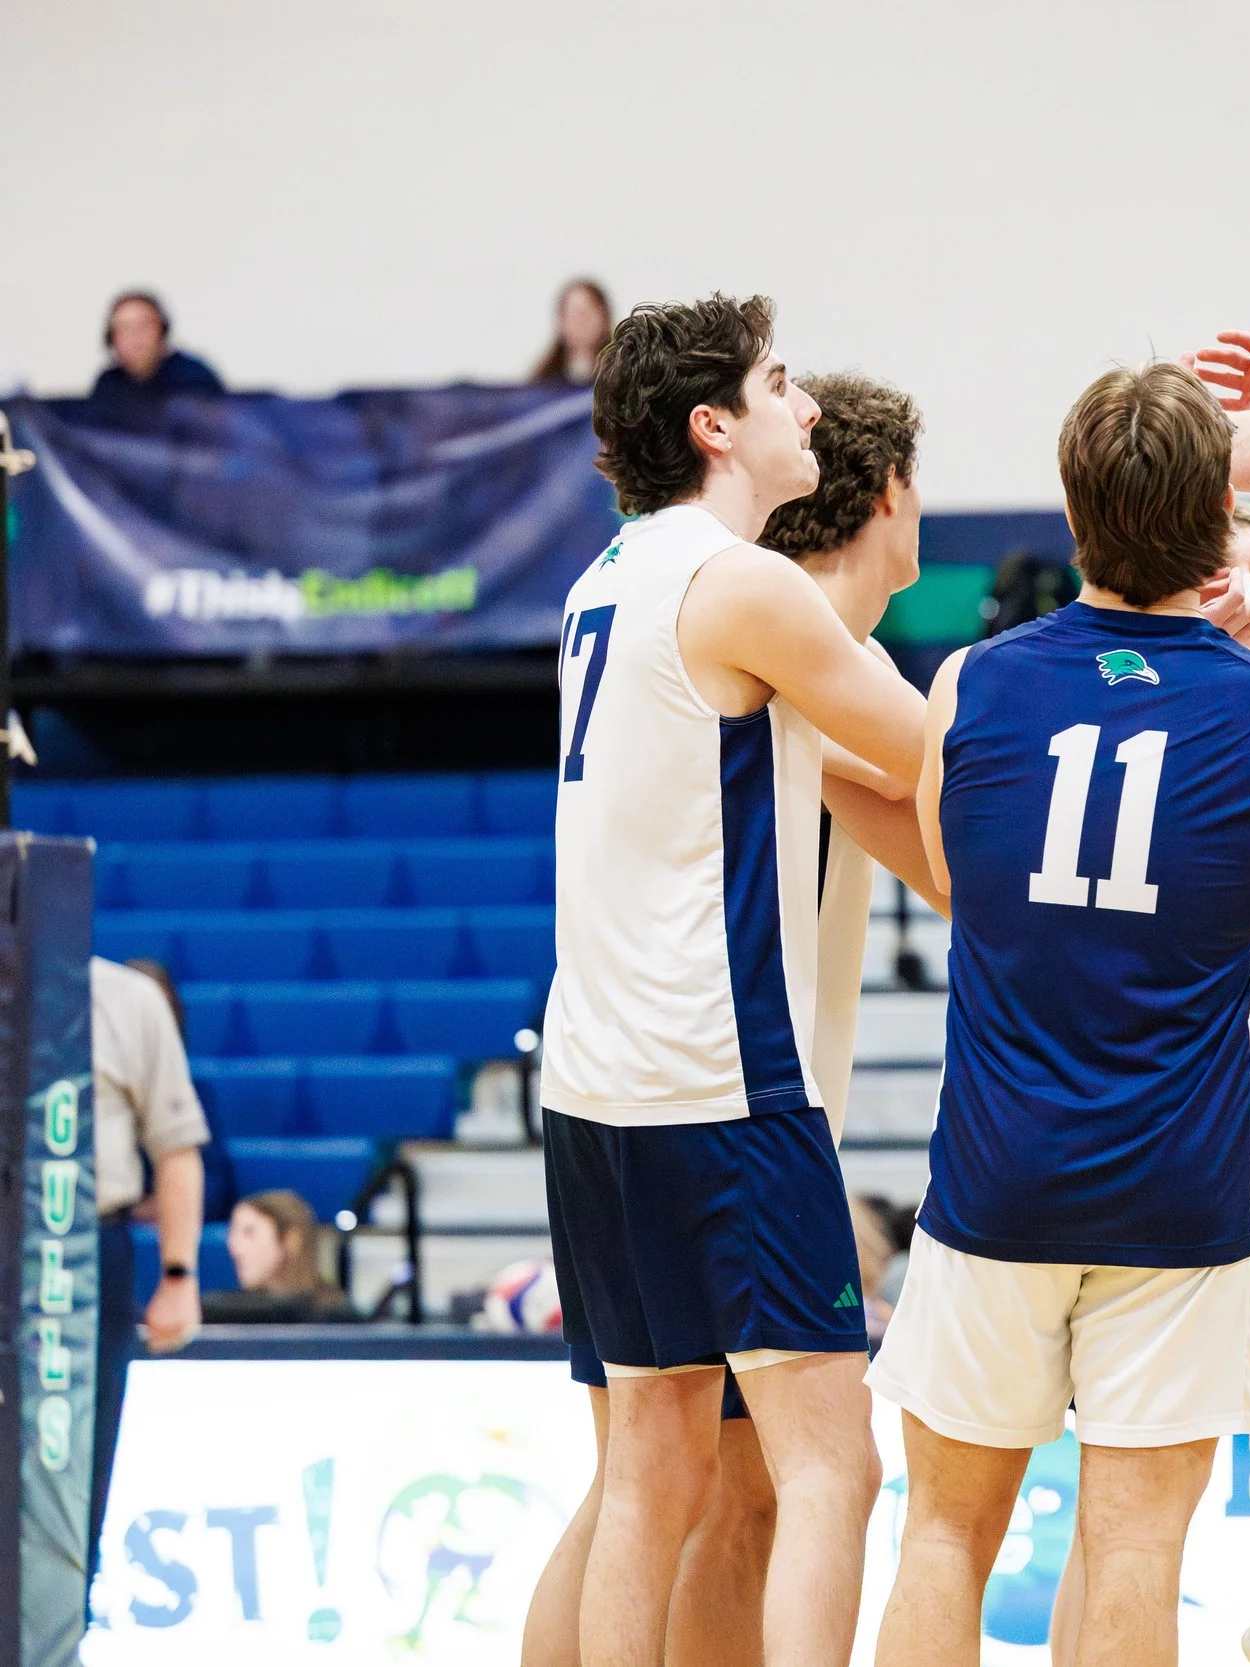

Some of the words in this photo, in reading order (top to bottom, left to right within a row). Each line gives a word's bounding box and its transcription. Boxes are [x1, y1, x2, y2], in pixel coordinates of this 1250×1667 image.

[561, 604, 617, 782] 7
[1029, 723, 1168, 914] 11
[38, 1079, 80, 1471] GULLS
[96, 1455, 343, 1645] ST!
